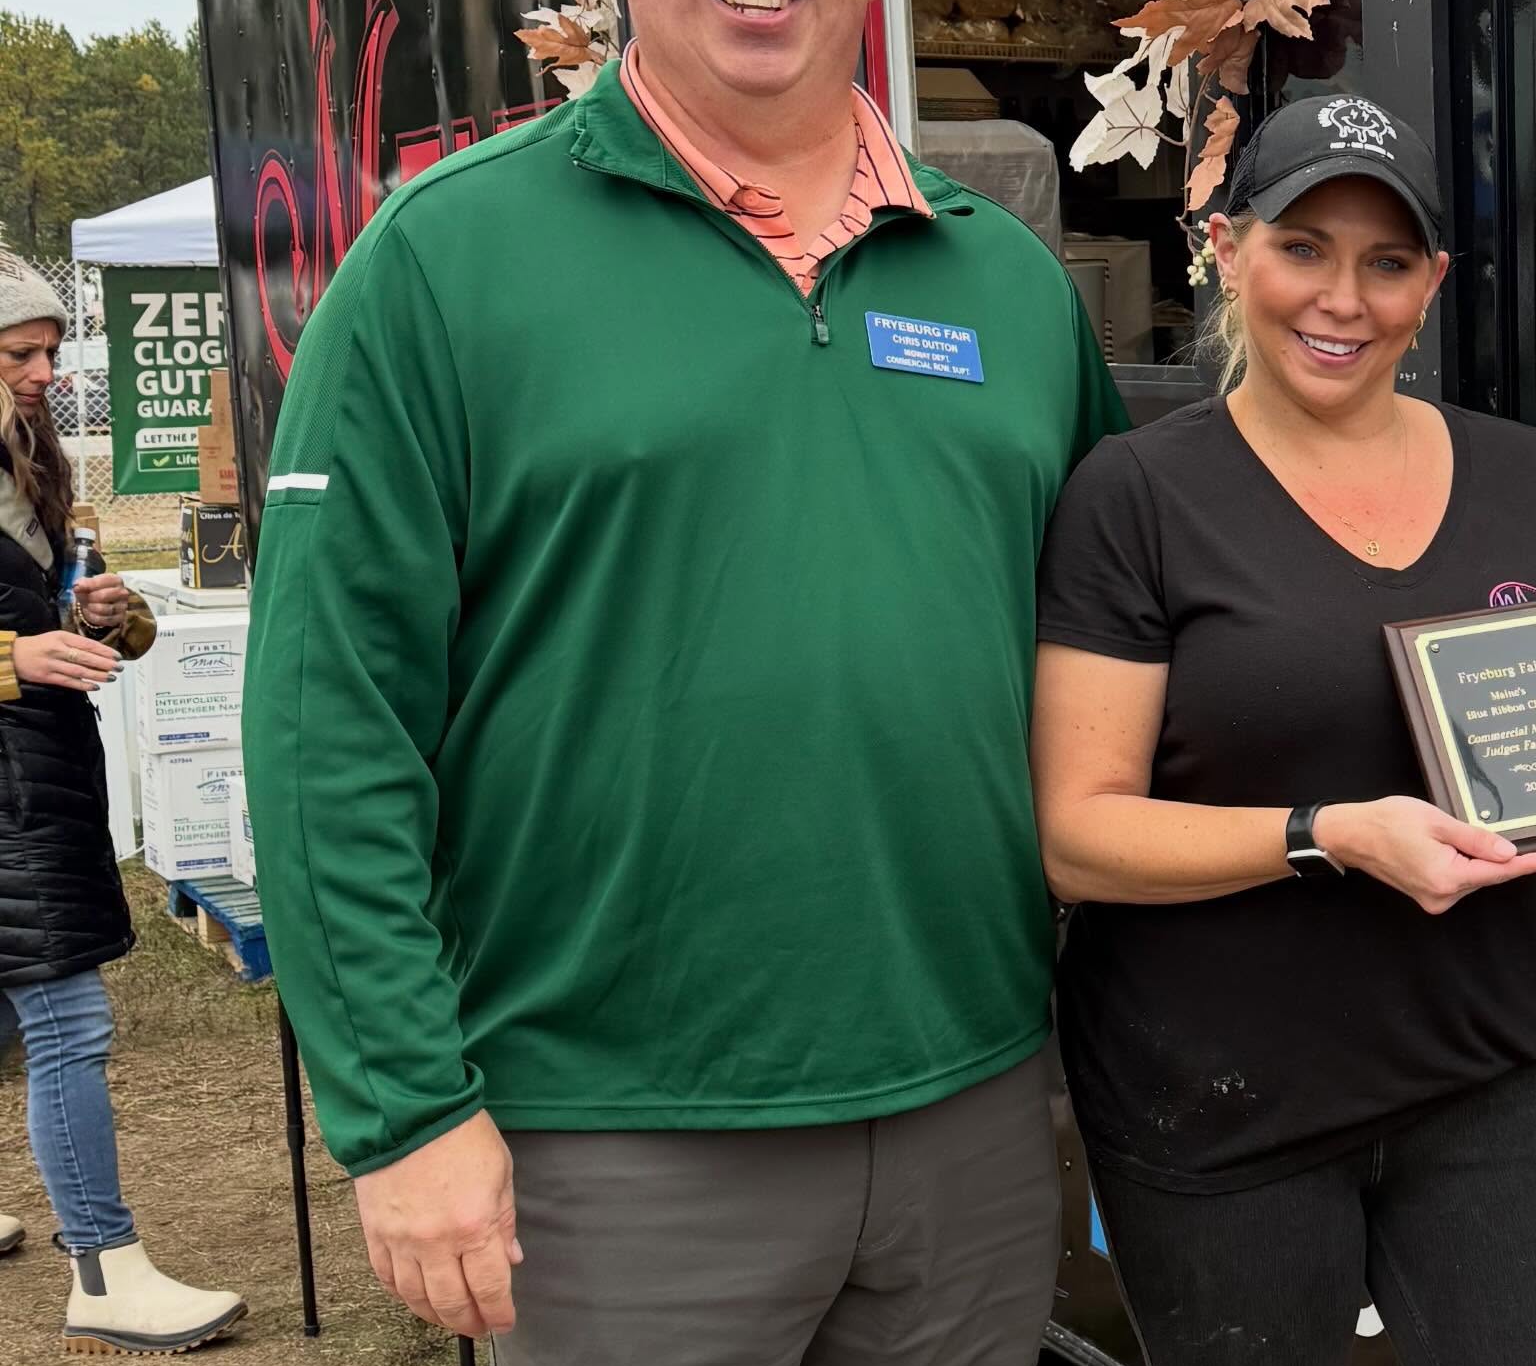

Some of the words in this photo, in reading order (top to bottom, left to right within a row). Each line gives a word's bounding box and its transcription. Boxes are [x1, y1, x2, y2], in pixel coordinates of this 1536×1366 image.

[874, 317, 941, 337] FRYEBURG
[944, 329, 971, 342] FAIR
[893, 334, 920, 347] CHRIS
[134, 339, 228, 366] CLOG
[136, 369, 212, 396] GUT
[144, 434, 162, 443] LET
[166, 433, 187, 442] THE
[1457, 667, 1516, 684] Fryeburg
[1490, 687, 1526, 701] Maine's
[1466, 710, 1489, 721] Blue
[1491, 703, 1526, 716] Ribbon
[1468, 725, 1528, 745] Commercial
[1483, 744, 1520, 758] Judges
